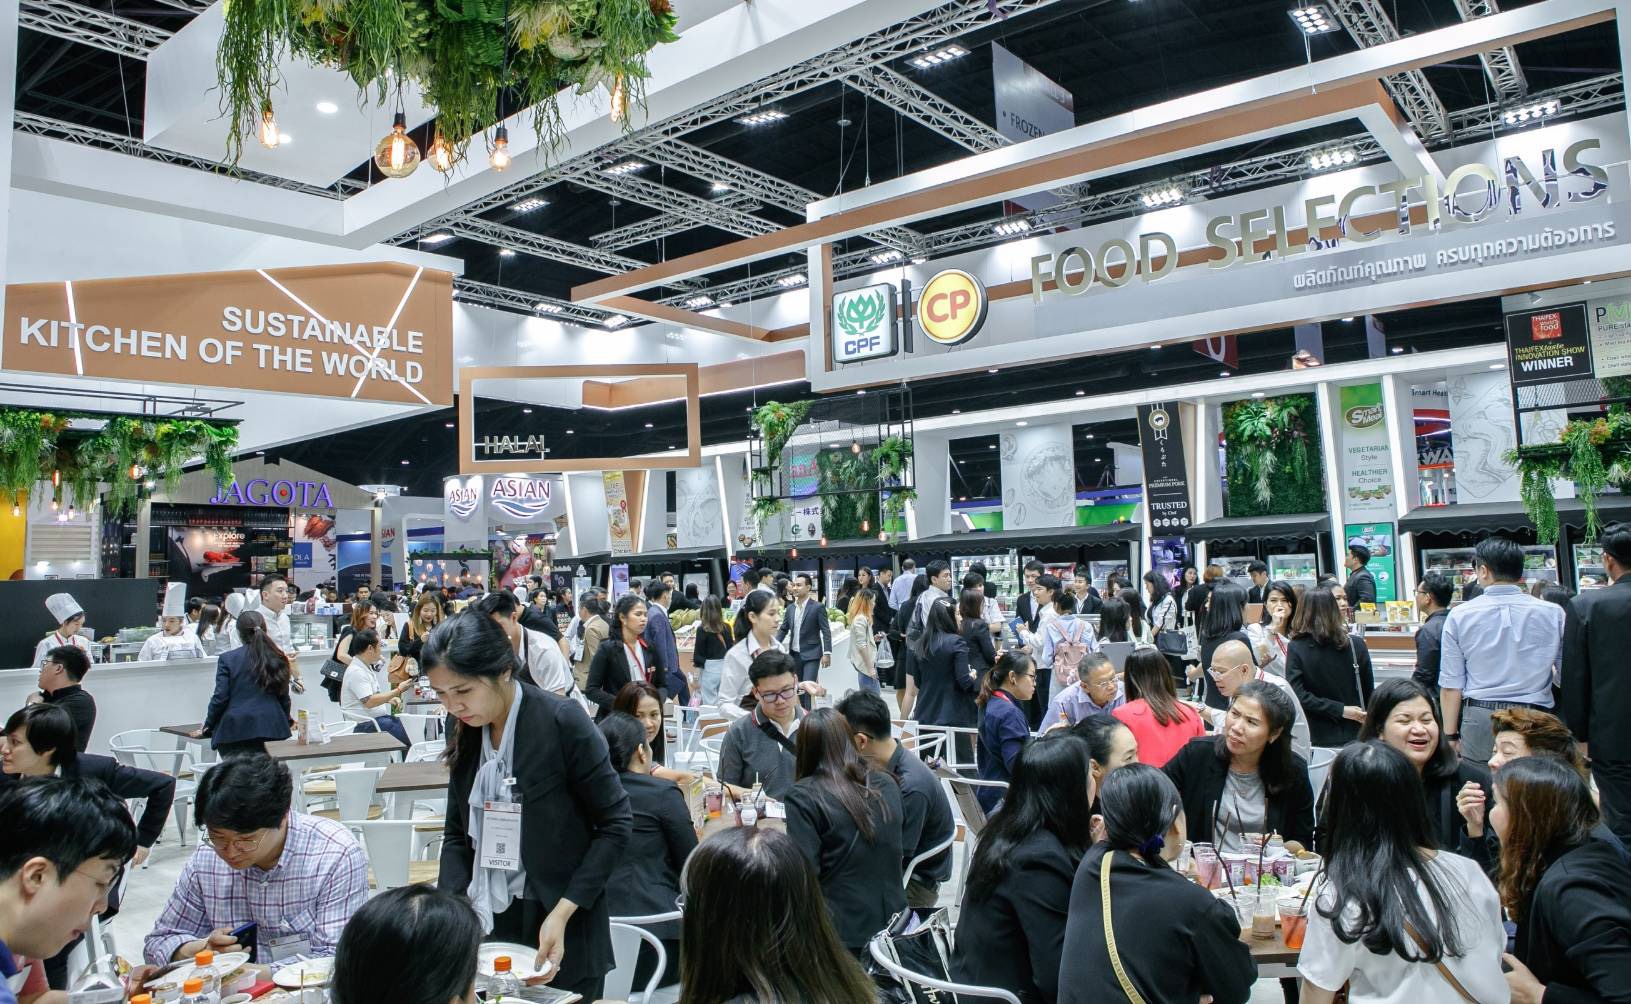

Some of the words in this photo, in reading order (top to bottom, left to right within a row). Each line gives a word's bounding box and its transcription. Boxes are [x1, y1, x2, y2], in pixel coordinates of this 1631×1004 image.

[1031, 231, 1179, 305] FOOD
[1205, 138, 1609, 270] SELECTIONS
[926, 289, 971, 323] CP
[222, 306, 424, 354] SUSTAINABLE
[20, 316, 188, 361] KITCHEN
[198, 337, 244, 366] OF
[252, 343, 313, 373] THE
[321, 351, 423, 384] WORLD
[844, 335, 880, 355] CPF
[1515, 350, 1560, 361] INNOVATION
[1561, 346, 1586, 356] SHOW
[1521, 356, 1574, 373] WINNER
[484, 434, 551, 455] HALAL
[1348, 445, 1389, 454] VEGETARIAN
[209, 478, 334, 508] JAGOTA
[449, 487, 478, 502] ASIAN
[493, 479, 551, 499] ASIAN
[1150, 502, 1188, 511] TRUSTED
[488, 859, 511, 867] VISITOR
